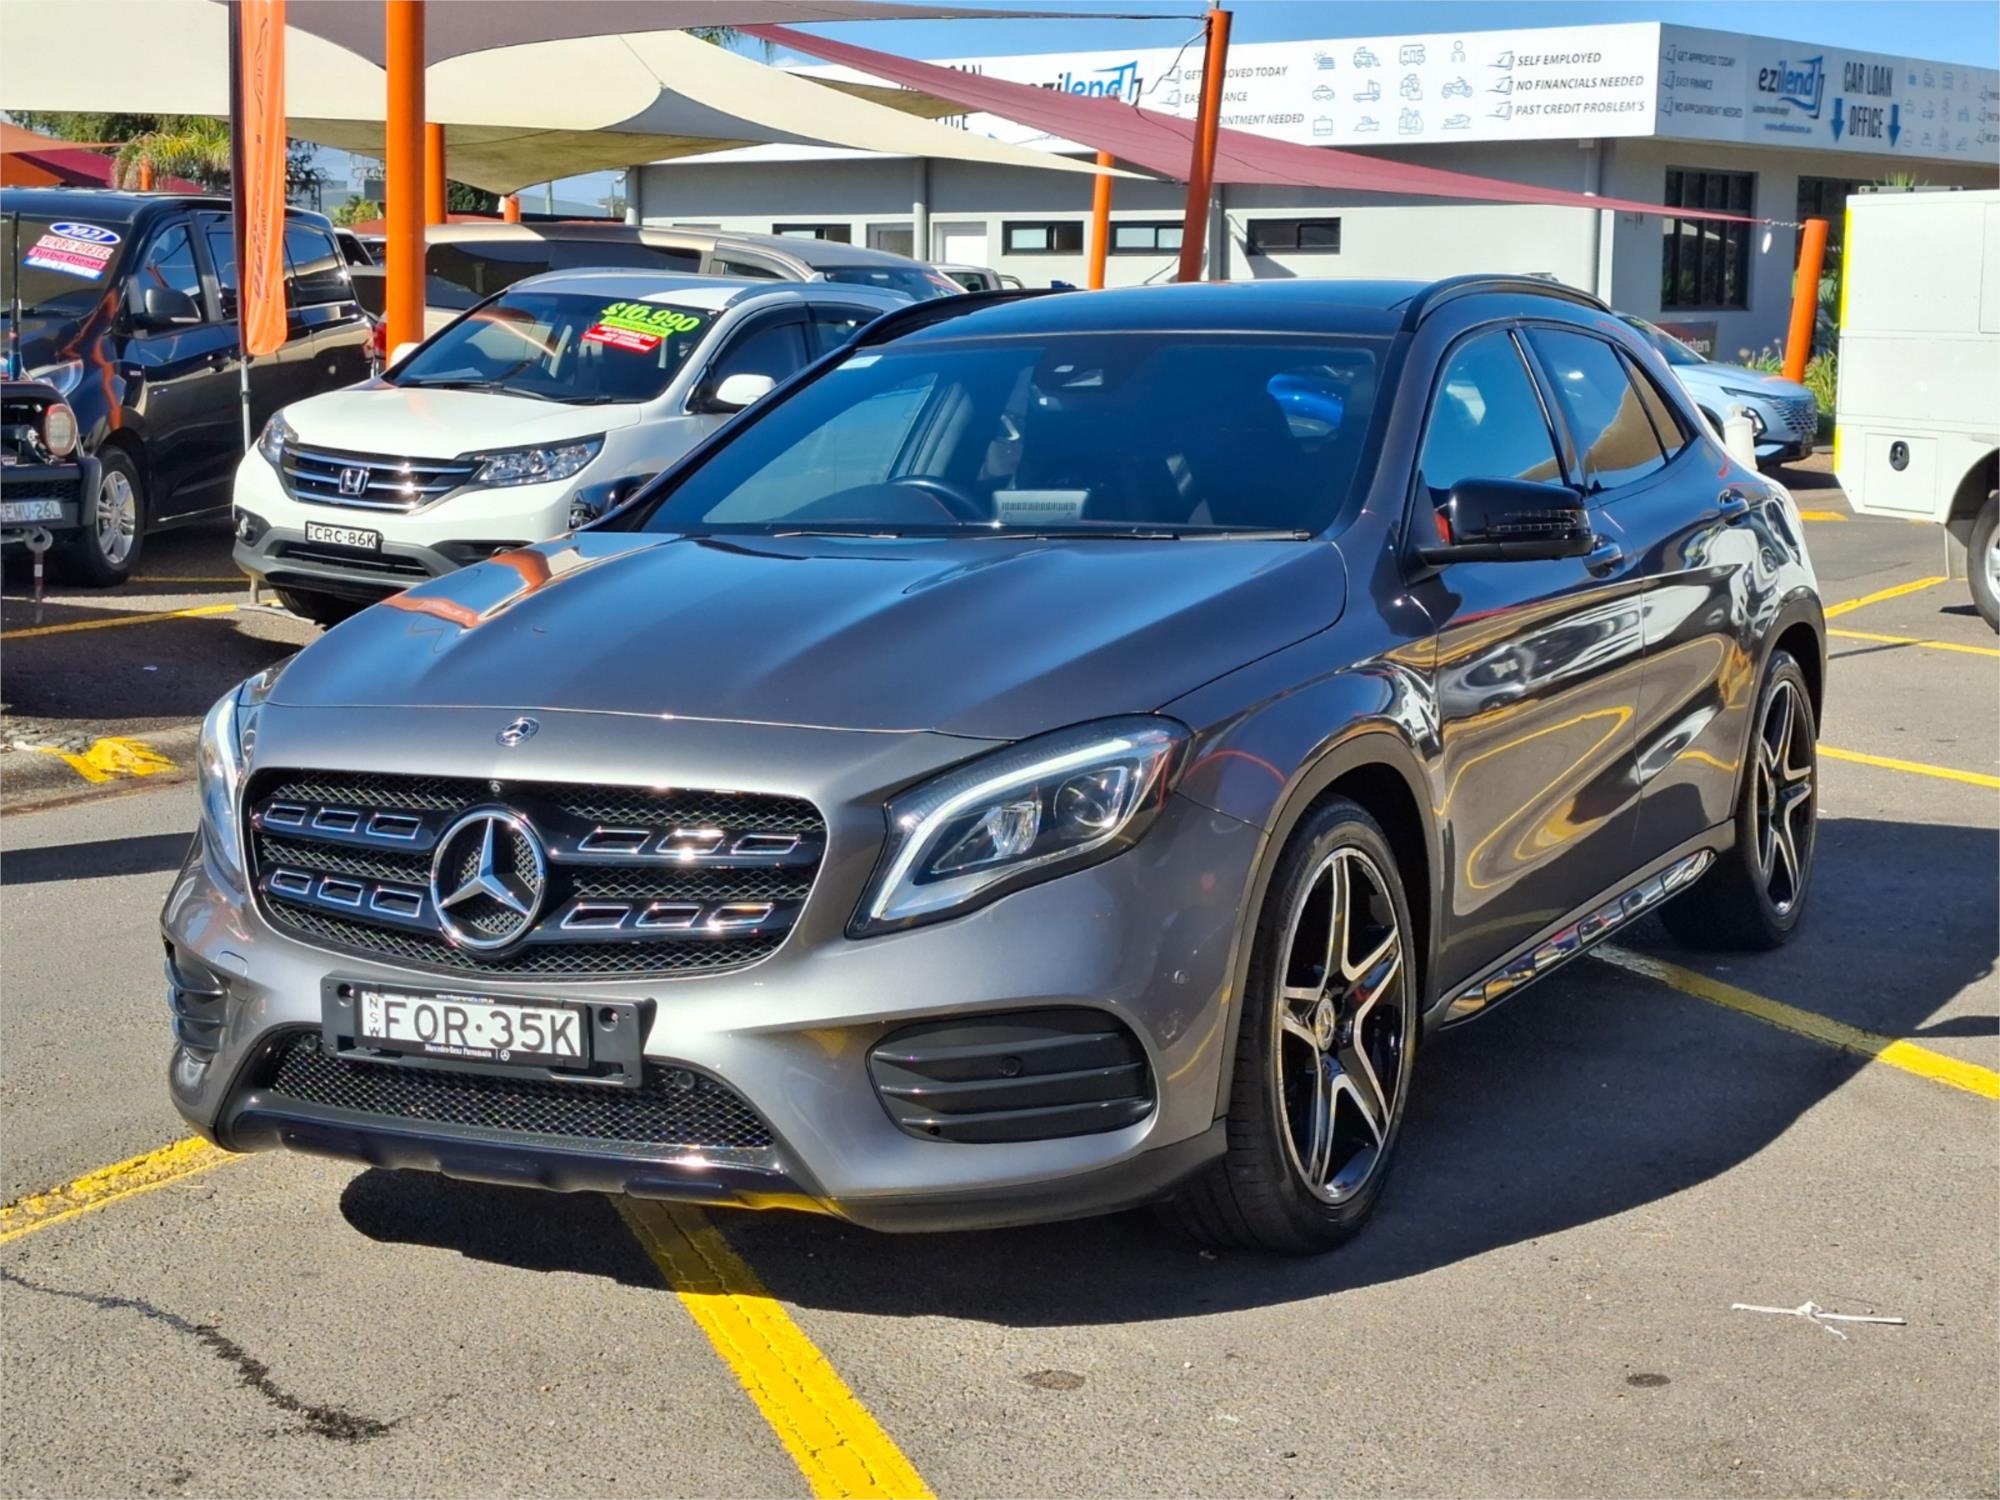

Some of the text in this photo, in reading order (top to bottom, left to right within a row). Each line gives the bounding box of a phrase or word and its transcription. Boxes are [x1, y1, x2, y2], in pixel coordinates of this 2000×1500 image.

[1517, 52, 1602, 66] SELF EMPLOYED
[1255, 66, 1288, 77] TODAY
[1758, 59, 1818, 97] ezilend
[1844, 61, 1894, 97] CAR LOAN
[1516, 75, 1645, 91] NO FINANCIALS NEEDED
[1184, 92, 1248, 104] EAS ANCE
[1515, 101, 1645, 115] PAST CREDIT PROBLEM'S
[1267, 113, 1305, 124] NEEDED
[1849, 105, 1884, 139] OFFICE
[61, 224, 113, 241] 2021
